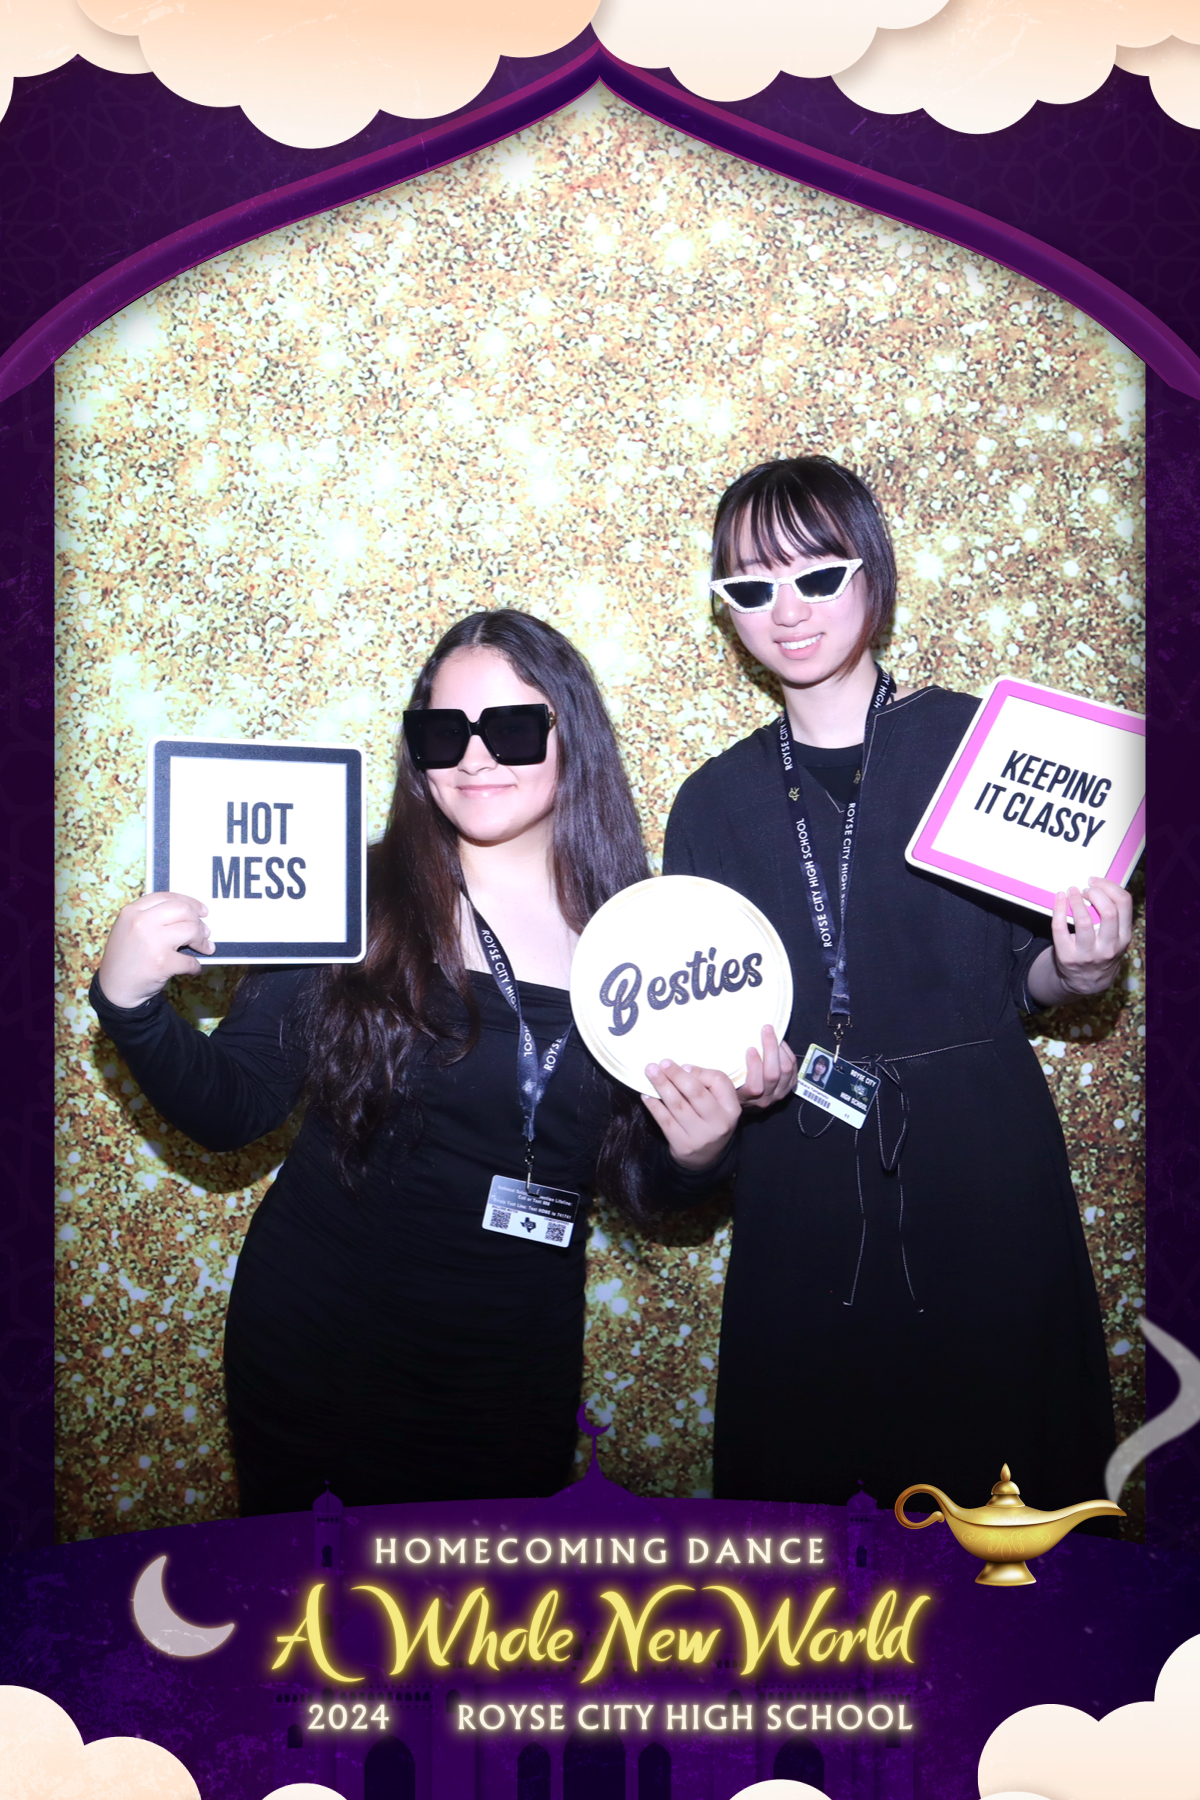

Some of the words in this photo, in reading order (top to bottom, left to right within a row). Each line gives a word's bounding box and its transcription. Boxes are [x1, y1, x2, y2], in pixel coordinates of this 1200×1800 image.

[873, 685, 888, 709] HIGH
[780, 723, 789, 741] CITY
[780, 741, 794, 771] ROYSE
[1000, 749, 1112, 809] KEEPING
[226, 801, 294, 845] HOT
[844, 802, 857, 836] ROYSE
[973, 781, 1007, 815] IT
[1002, 791, 1106, 848] CLASSY
[795, 818, 813, 860] SCHOOL
[841, 838, 852, 860] CITY
[212, 856, 307, 900] MESS
[804, 860, 819, 888] HIGH
[840, 863, 849, 891] HIGH
[811, 890, 825, 912] CITY
[816, 913, 833, 948] ROYSE
[481, 929, 502, 961] ROYSE
[494, 962, 511, 983] CITY
[599, 946, 764, 1037] Besties
[865, 1077, 877, 1087] CITY
[851, 1097, 868, 1111] SCHOOL
